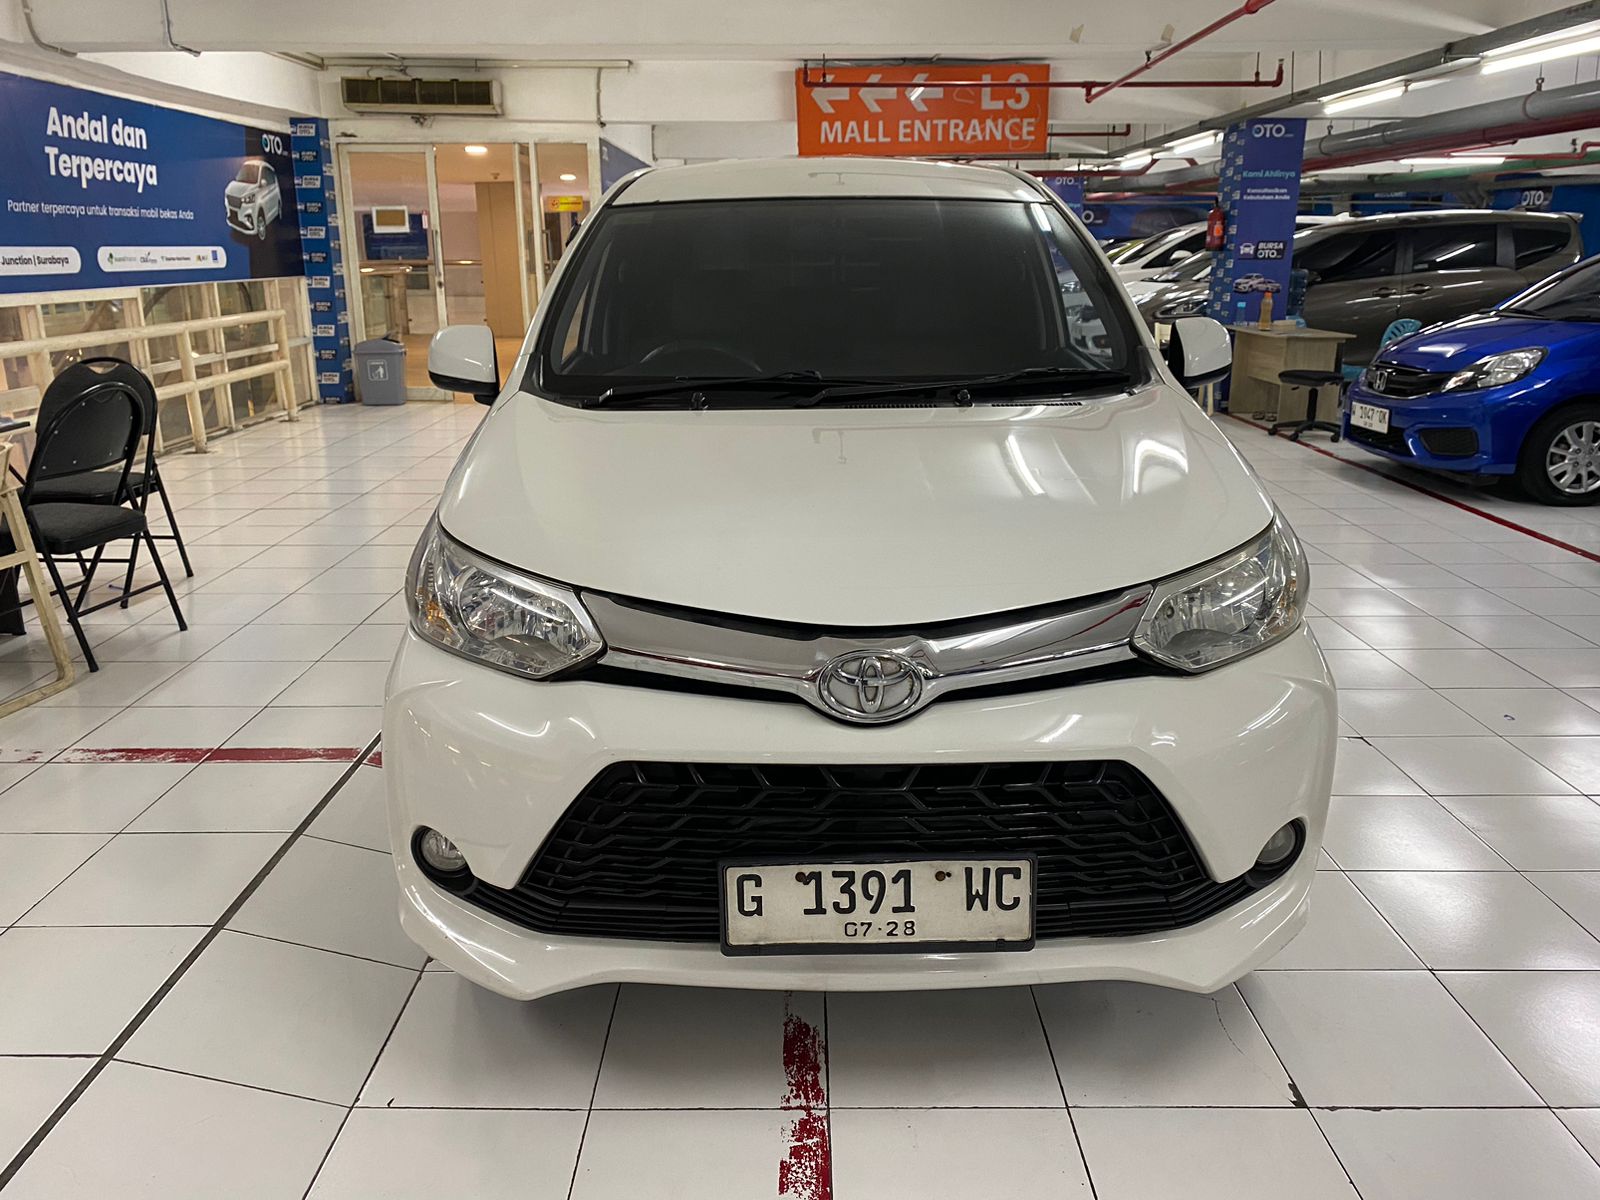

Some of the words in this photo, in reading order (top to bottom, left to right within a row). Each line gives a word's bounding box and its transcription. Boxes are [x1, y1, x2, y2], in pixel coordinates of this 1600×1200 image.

[981, 73, 1030, 111] L3
[46, 106, 109, 144] Andal
[111, 118, 147, 150] dan
[820, 120, 891, 143] MALL
[898, 118, 1035, 142] ENTRANCE
[1252, 124, 1285, 138] OTO
[262, 133, 283, 155] OTO
[44, 146, 157, 193] Terpercaya
[1055, 177, 1074, 185] OTO
[1521, 190, 1544, 205] OTO
[7, 199, 39, 213] Partner
[41, 202, 86, 218] terpercaya
[86, 204, 108, 217] untuk
[108, 206, 140, 217] transaksi
[140, 207, 159, 219] mobil
[159, 208, 178, 219] bekas
[178, 209, 194, 220] Anda
[1257, 249, 1277, 258] OTO
[1258, 242, 1284, 250] BURSA
[1, 255, 33, 267] Junction
[37, 255, 70, 268] Surabaya
[736, 874, 763, 917] G
[803, 869, 916, 915] 1391
[964, 866, 1022, 912] WC
